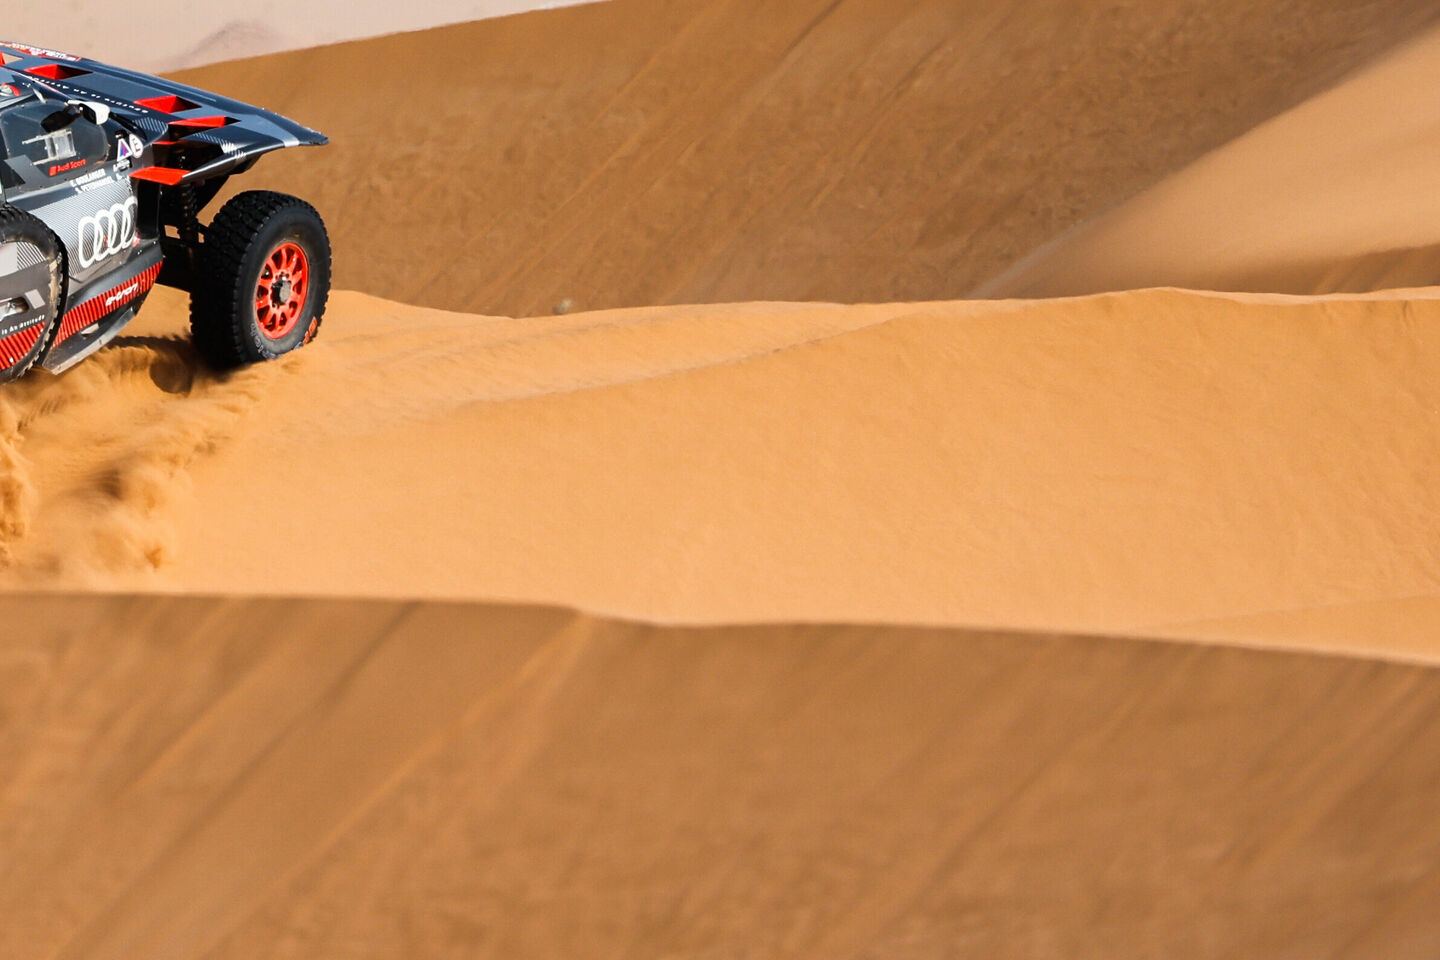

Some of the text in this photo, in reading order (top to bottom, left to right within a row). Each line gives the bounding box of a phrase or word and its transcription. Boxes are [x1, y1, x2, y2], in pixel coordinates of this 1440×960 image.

[57, 159, 87, 173] Audi Sport
[105, 282, 139, 307] e-tron
